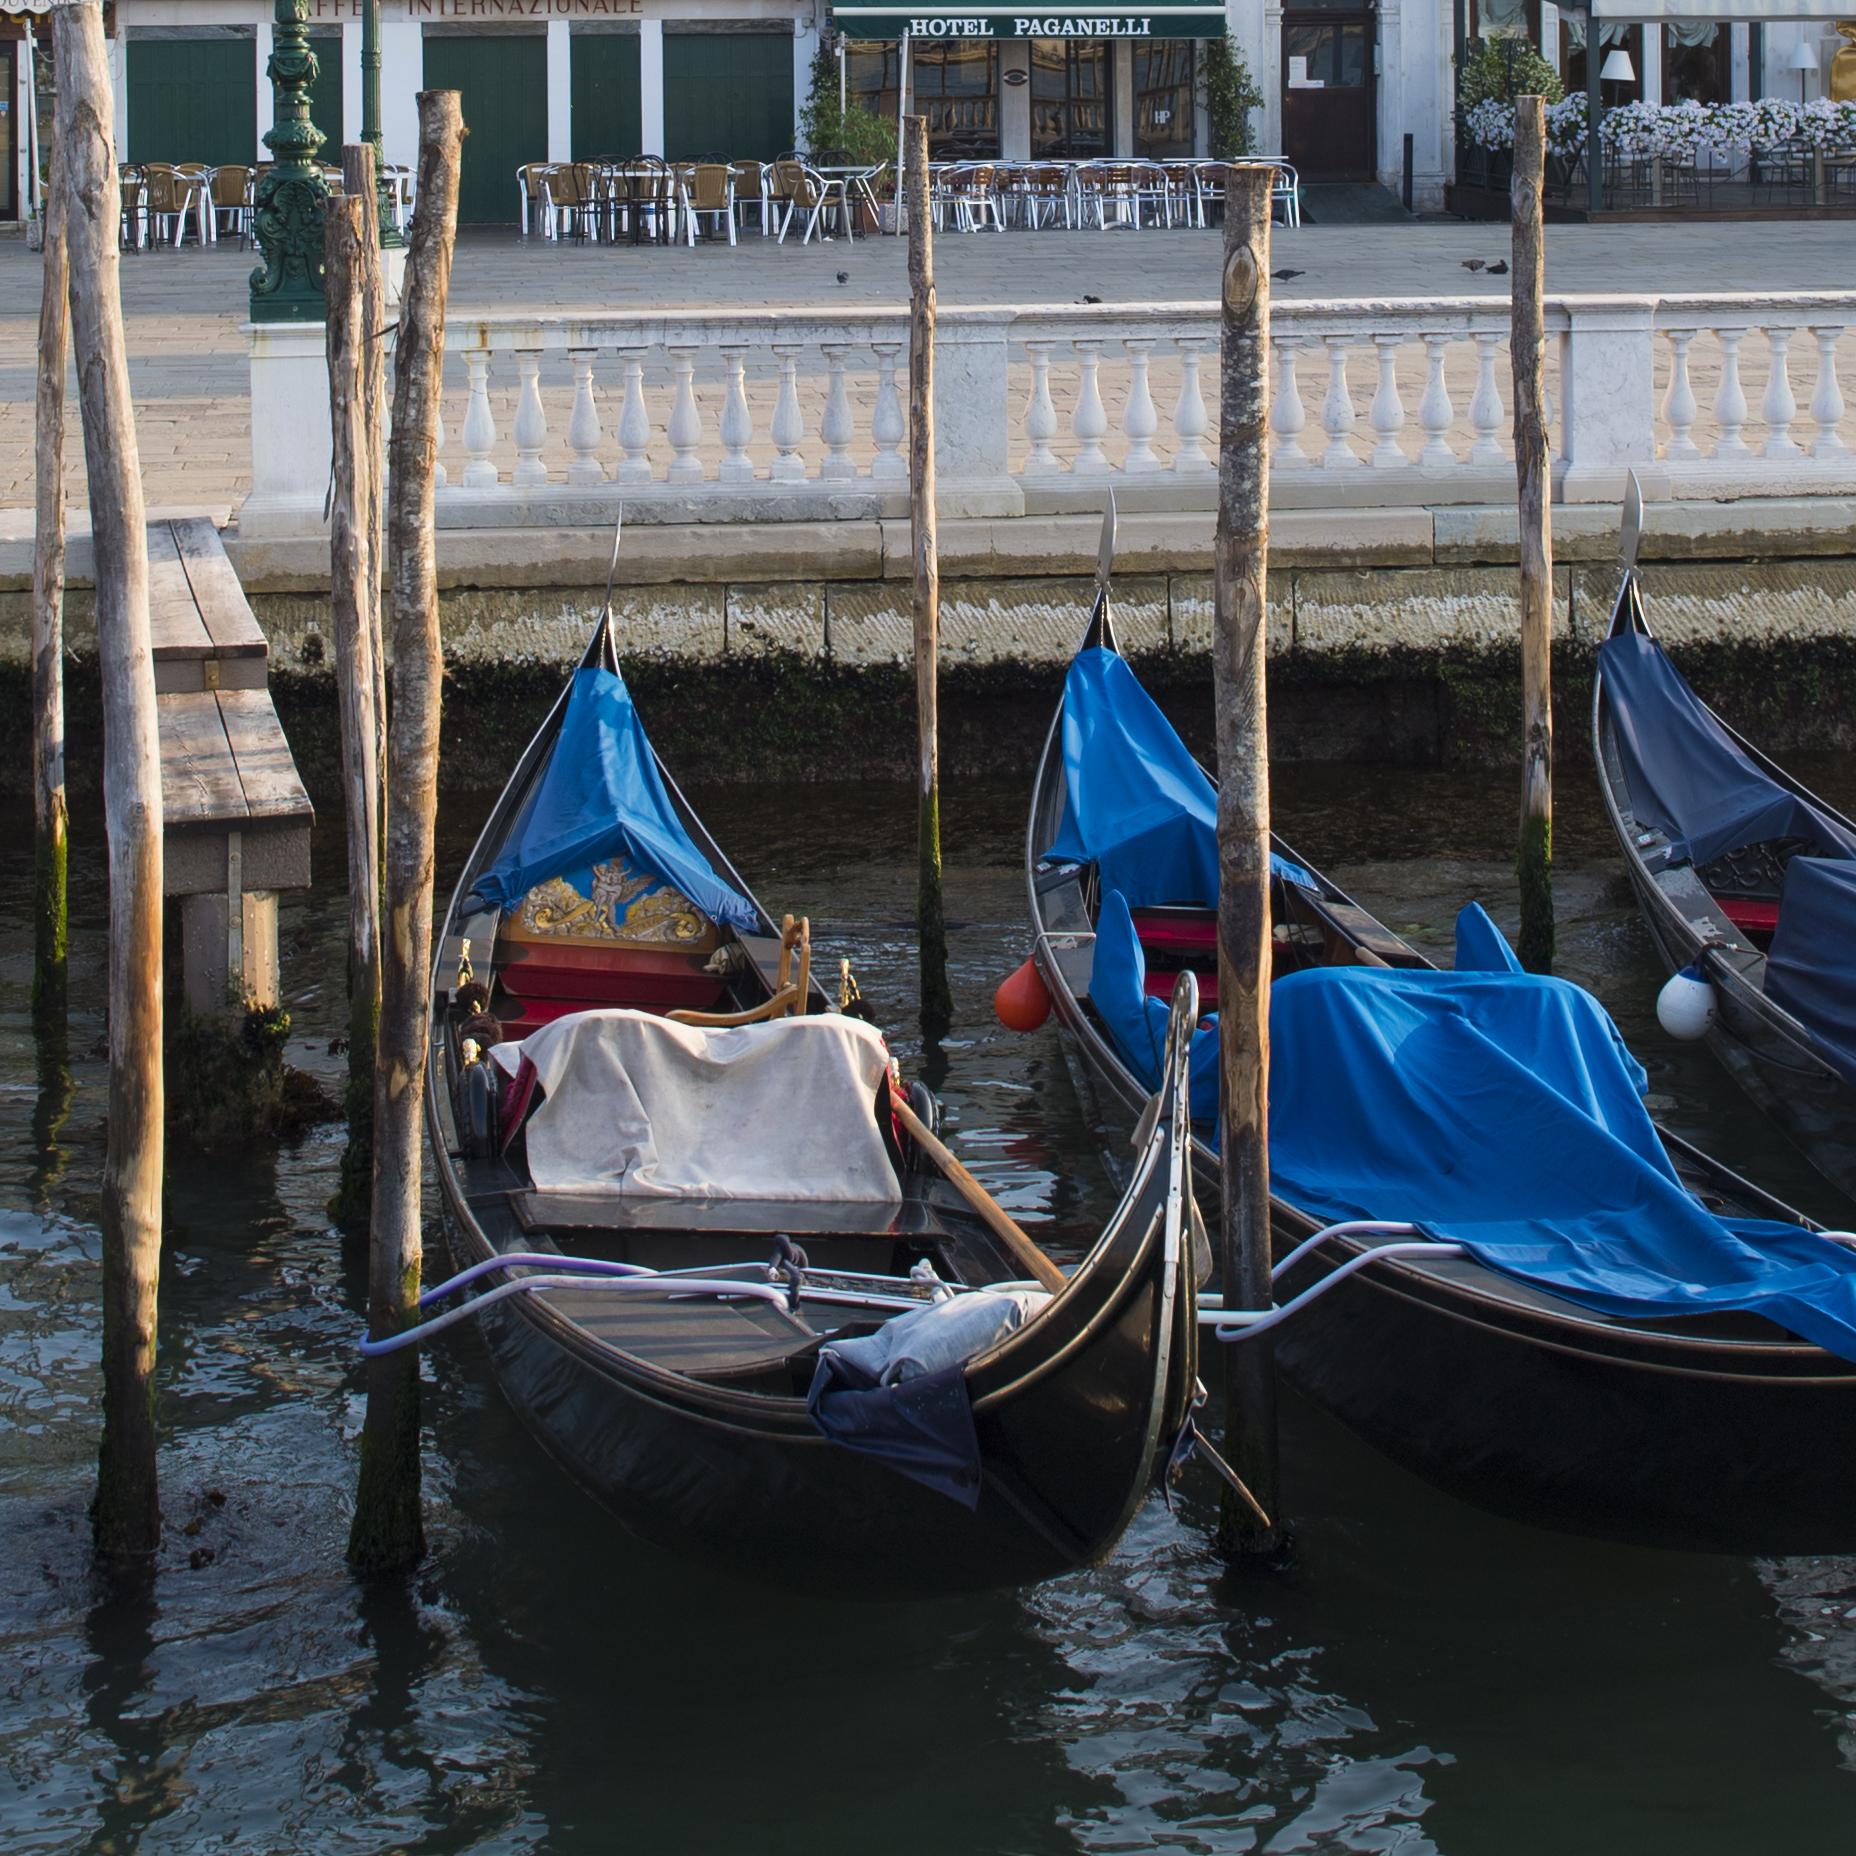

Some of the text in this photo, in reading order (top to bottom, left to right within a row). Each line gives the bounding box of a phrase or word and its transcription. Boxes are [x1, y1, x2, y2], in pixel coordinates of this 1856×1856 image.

[910, 17, 1151, 36] HOTEL PAGANELLI
[1154, 110, 1171, 124] HP
